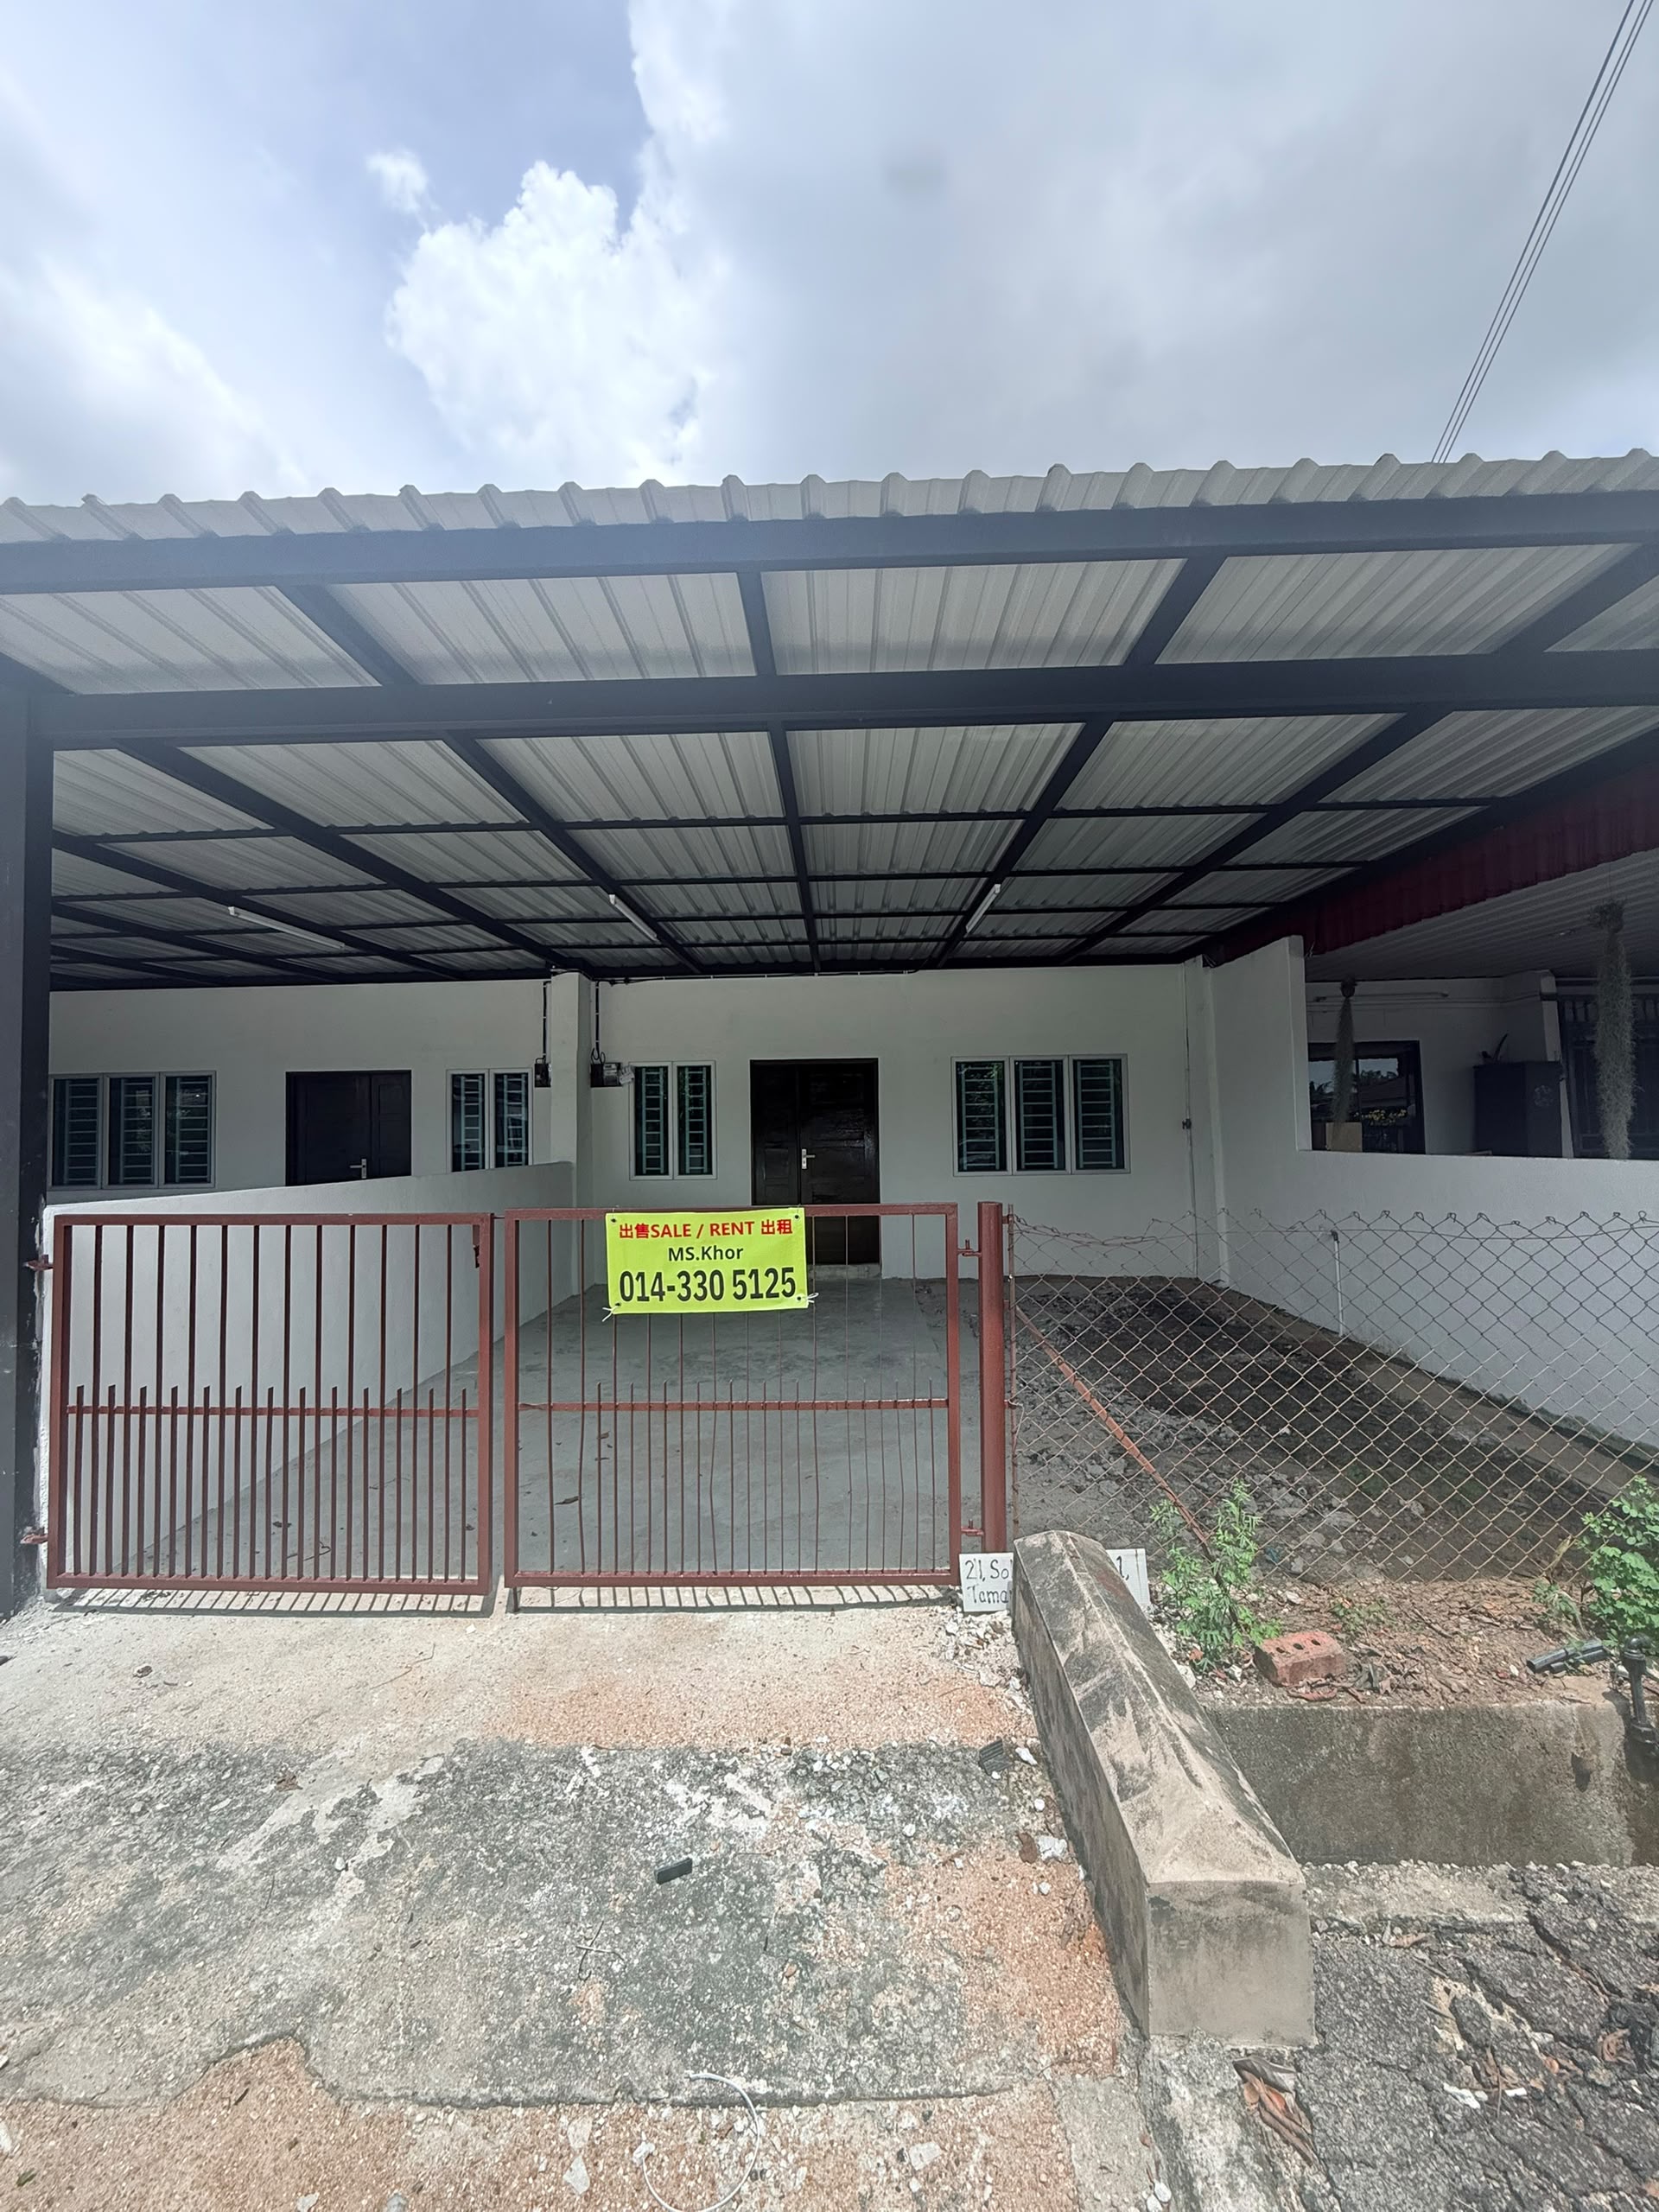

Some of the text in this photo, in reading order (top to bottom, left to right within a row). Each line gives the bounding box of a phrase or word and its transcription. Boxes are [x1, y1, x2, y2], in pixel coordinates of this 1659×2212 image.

[710, 1222, 754, 1236] RENT
[761, 1219, 792, 1235] 出租
[669, 1245, 744, 1261] MS.Khor
[620, 1268, 795, 1301] 014-330 5125
